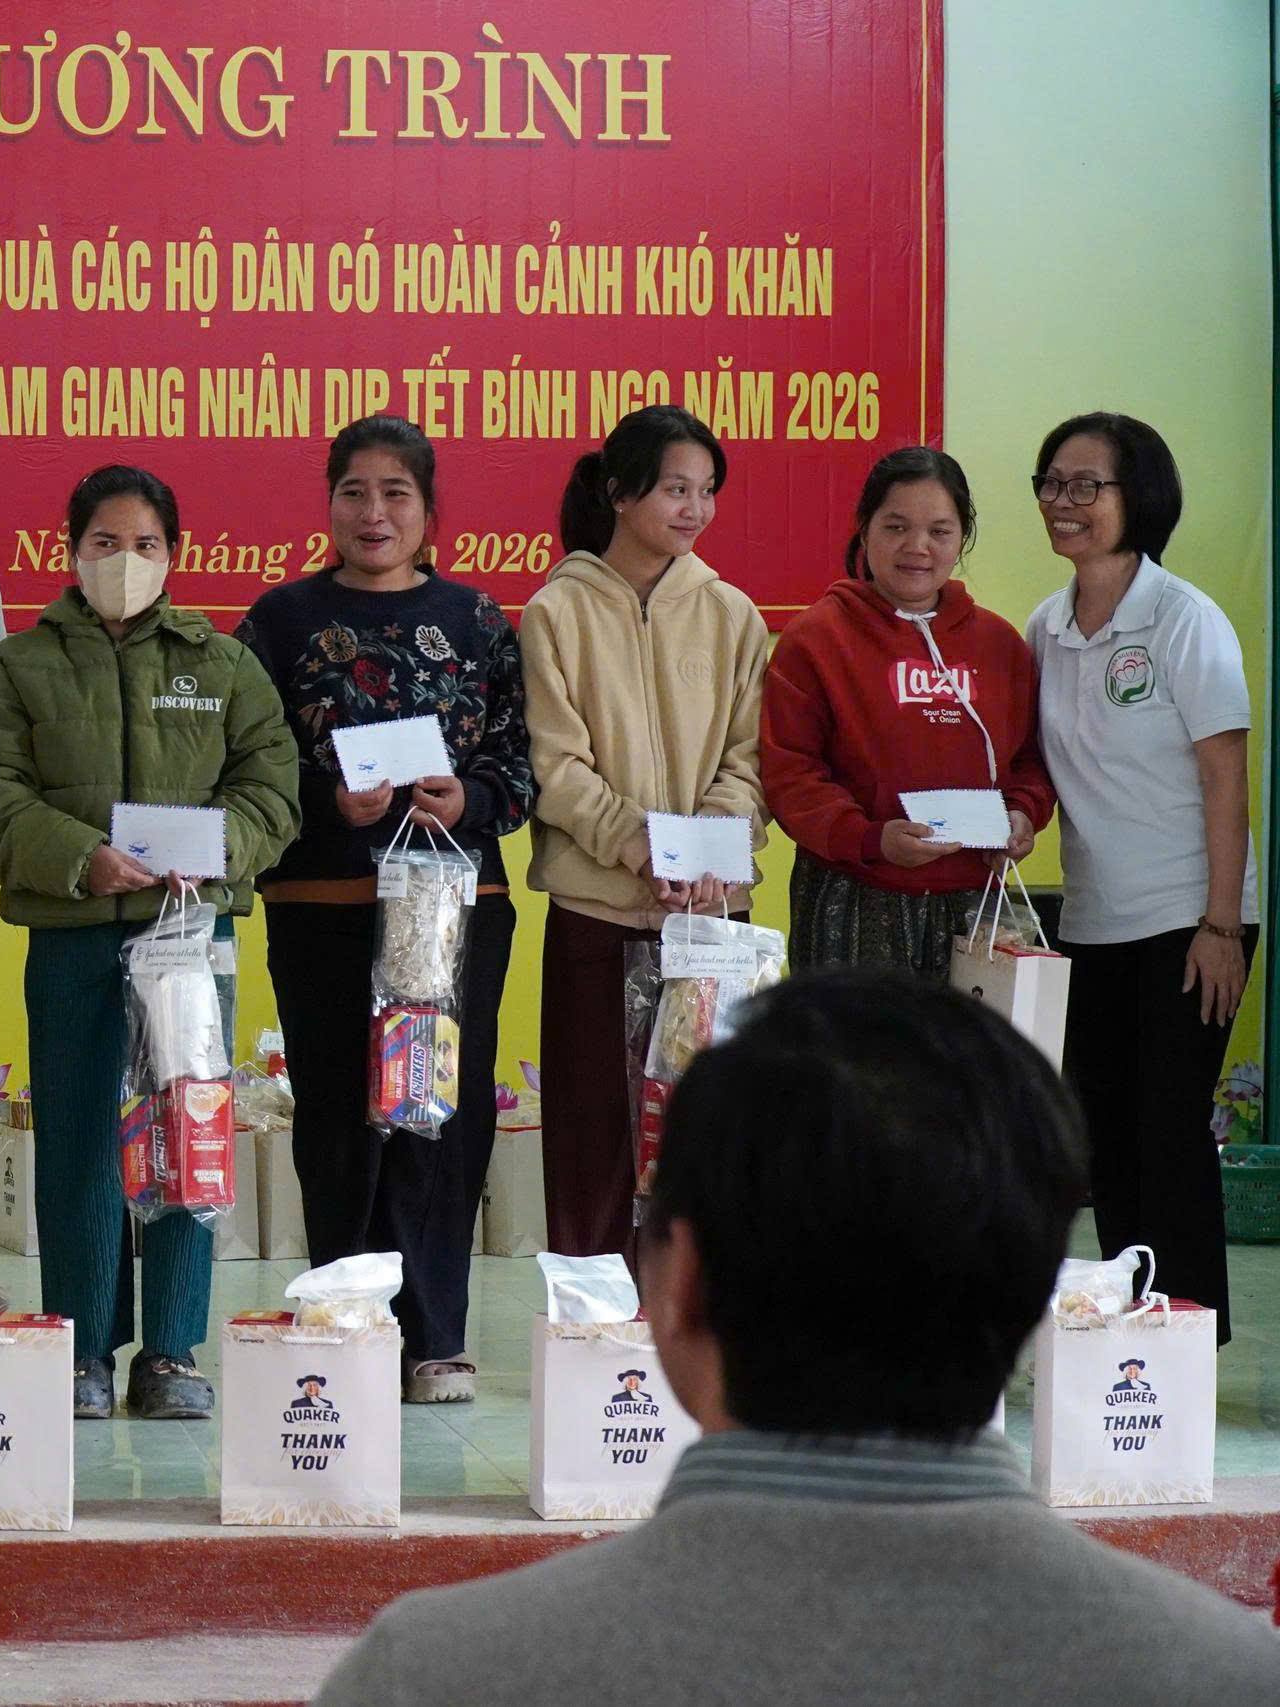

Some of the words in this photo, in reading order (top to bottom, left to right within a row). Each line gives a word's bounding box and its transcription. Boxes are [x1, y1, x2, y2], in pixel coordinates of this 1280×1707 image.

[326, 22, 673, 142] TRÌNH
[71, 226, 152, 312] CÁC
[166, 226, 218, 328] HỘ
[231, 226, 315, 313] DÂN
[328, 228, 381, 313] CÓ
[393, 228, 502, 314] HOÀN
[515, 220, 623, 315] CẢNH
[636, 231, 715, 316] KHÓ
[726, 232, 834, 318] KHĂN
[61, 366, 185, 438] GIANG
[198, 352, 311, 439] NHÂN
[402, 346, 470, 439] TẾT
[482, 354, 577, 440] BÍNH
[683, 355, 775, 441] NĂM
[786, 371, 881, 441] 2026
[172, 530, 293, 582] háng
[449, 531, 553, 574] 2026
[896, 661, 971, 704] Lazy
[151, 695, 224, 713] DISCOVERY
[922, 708, 940, 717] Sour
[1105, 1391, 1157, 1407] QUAKER
[282, 1408, 340, 1424] QUAKER
[603, 1402, 660, 1418] QUAKER
[1103, 1414, 1164, 1431] THANK
[280, 1433, 347, 1449] THANK
[601, 1427, 666, 1443] THANK
[1112, 1435, 1146, 1452] YOU
[291, 1454, 328, 1471] YOU
[611, 1449, 648, 1464] YOU
